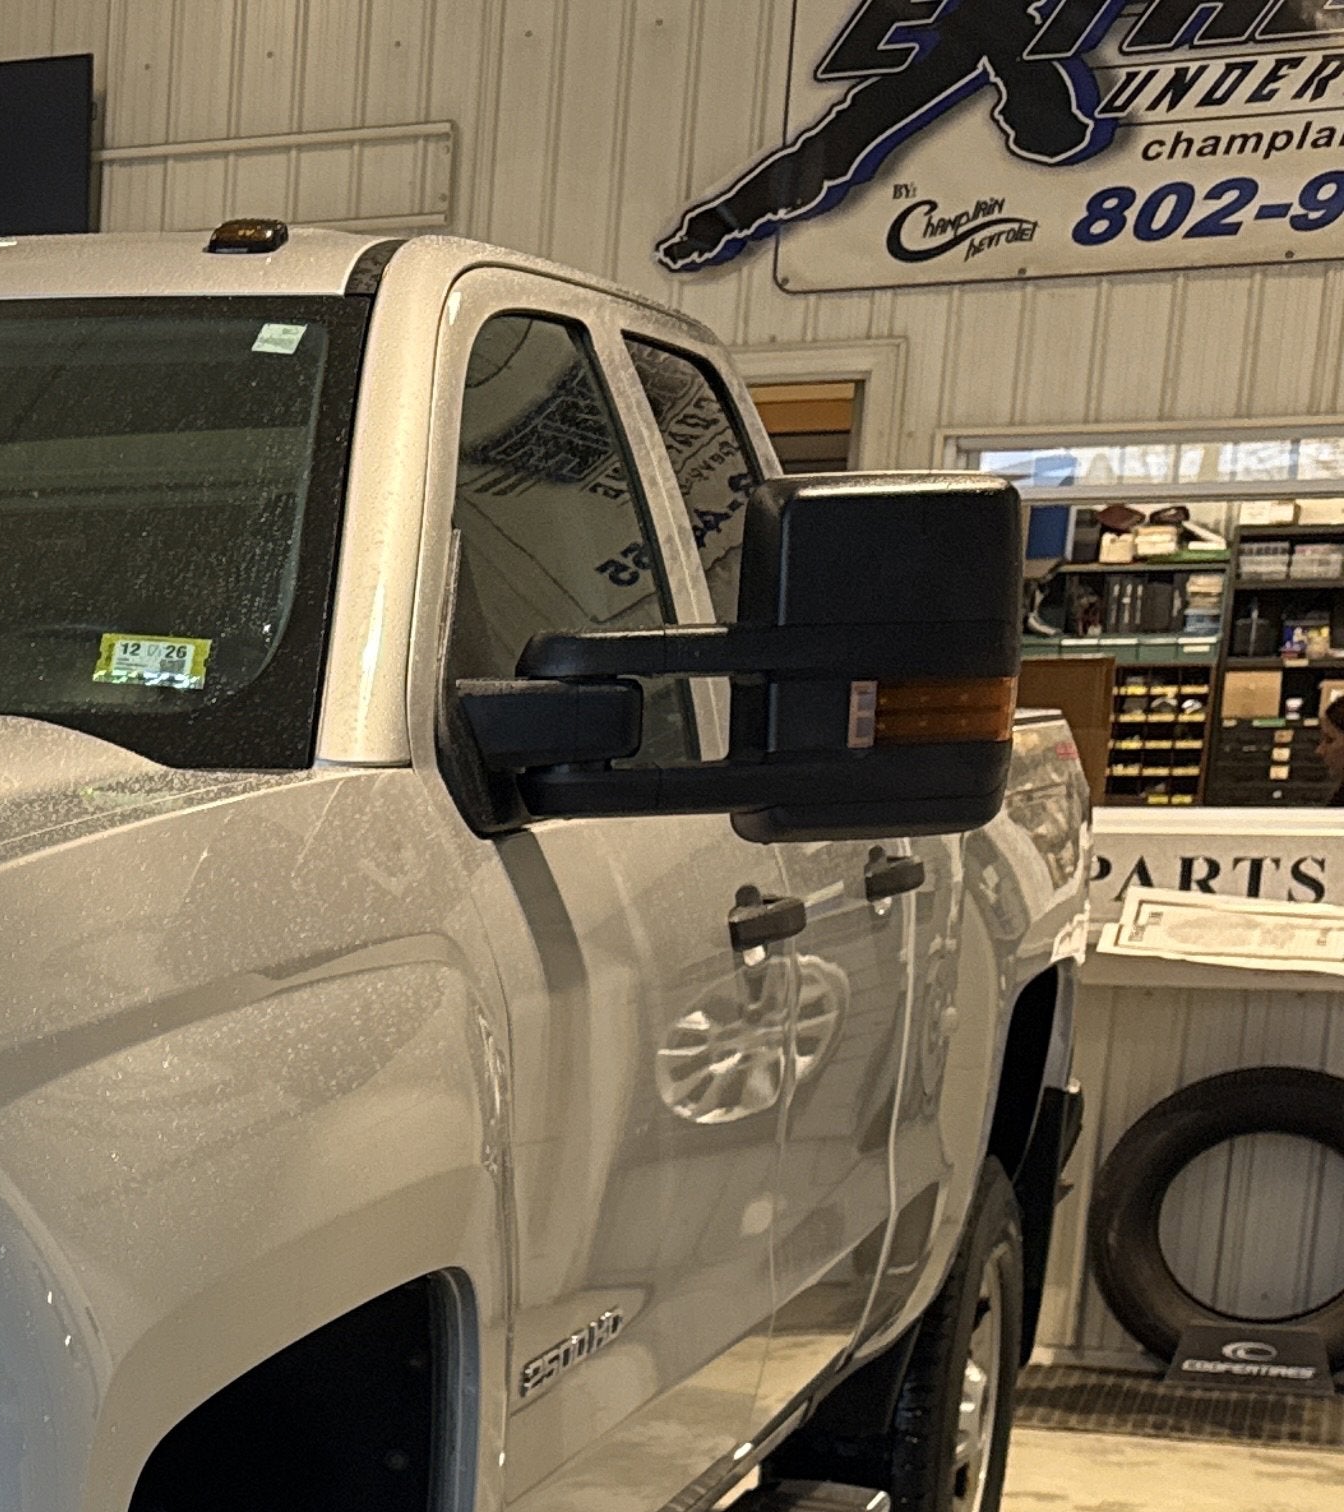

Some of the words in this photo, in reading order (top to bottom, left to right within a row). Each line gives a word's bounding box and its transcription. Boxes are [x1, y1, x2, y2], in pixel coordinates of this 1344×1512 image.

[1141, 120, 1344, 161] champla
[1071, 170, 1344, 246] 802-9
[120, 642, 142, 657] 12
